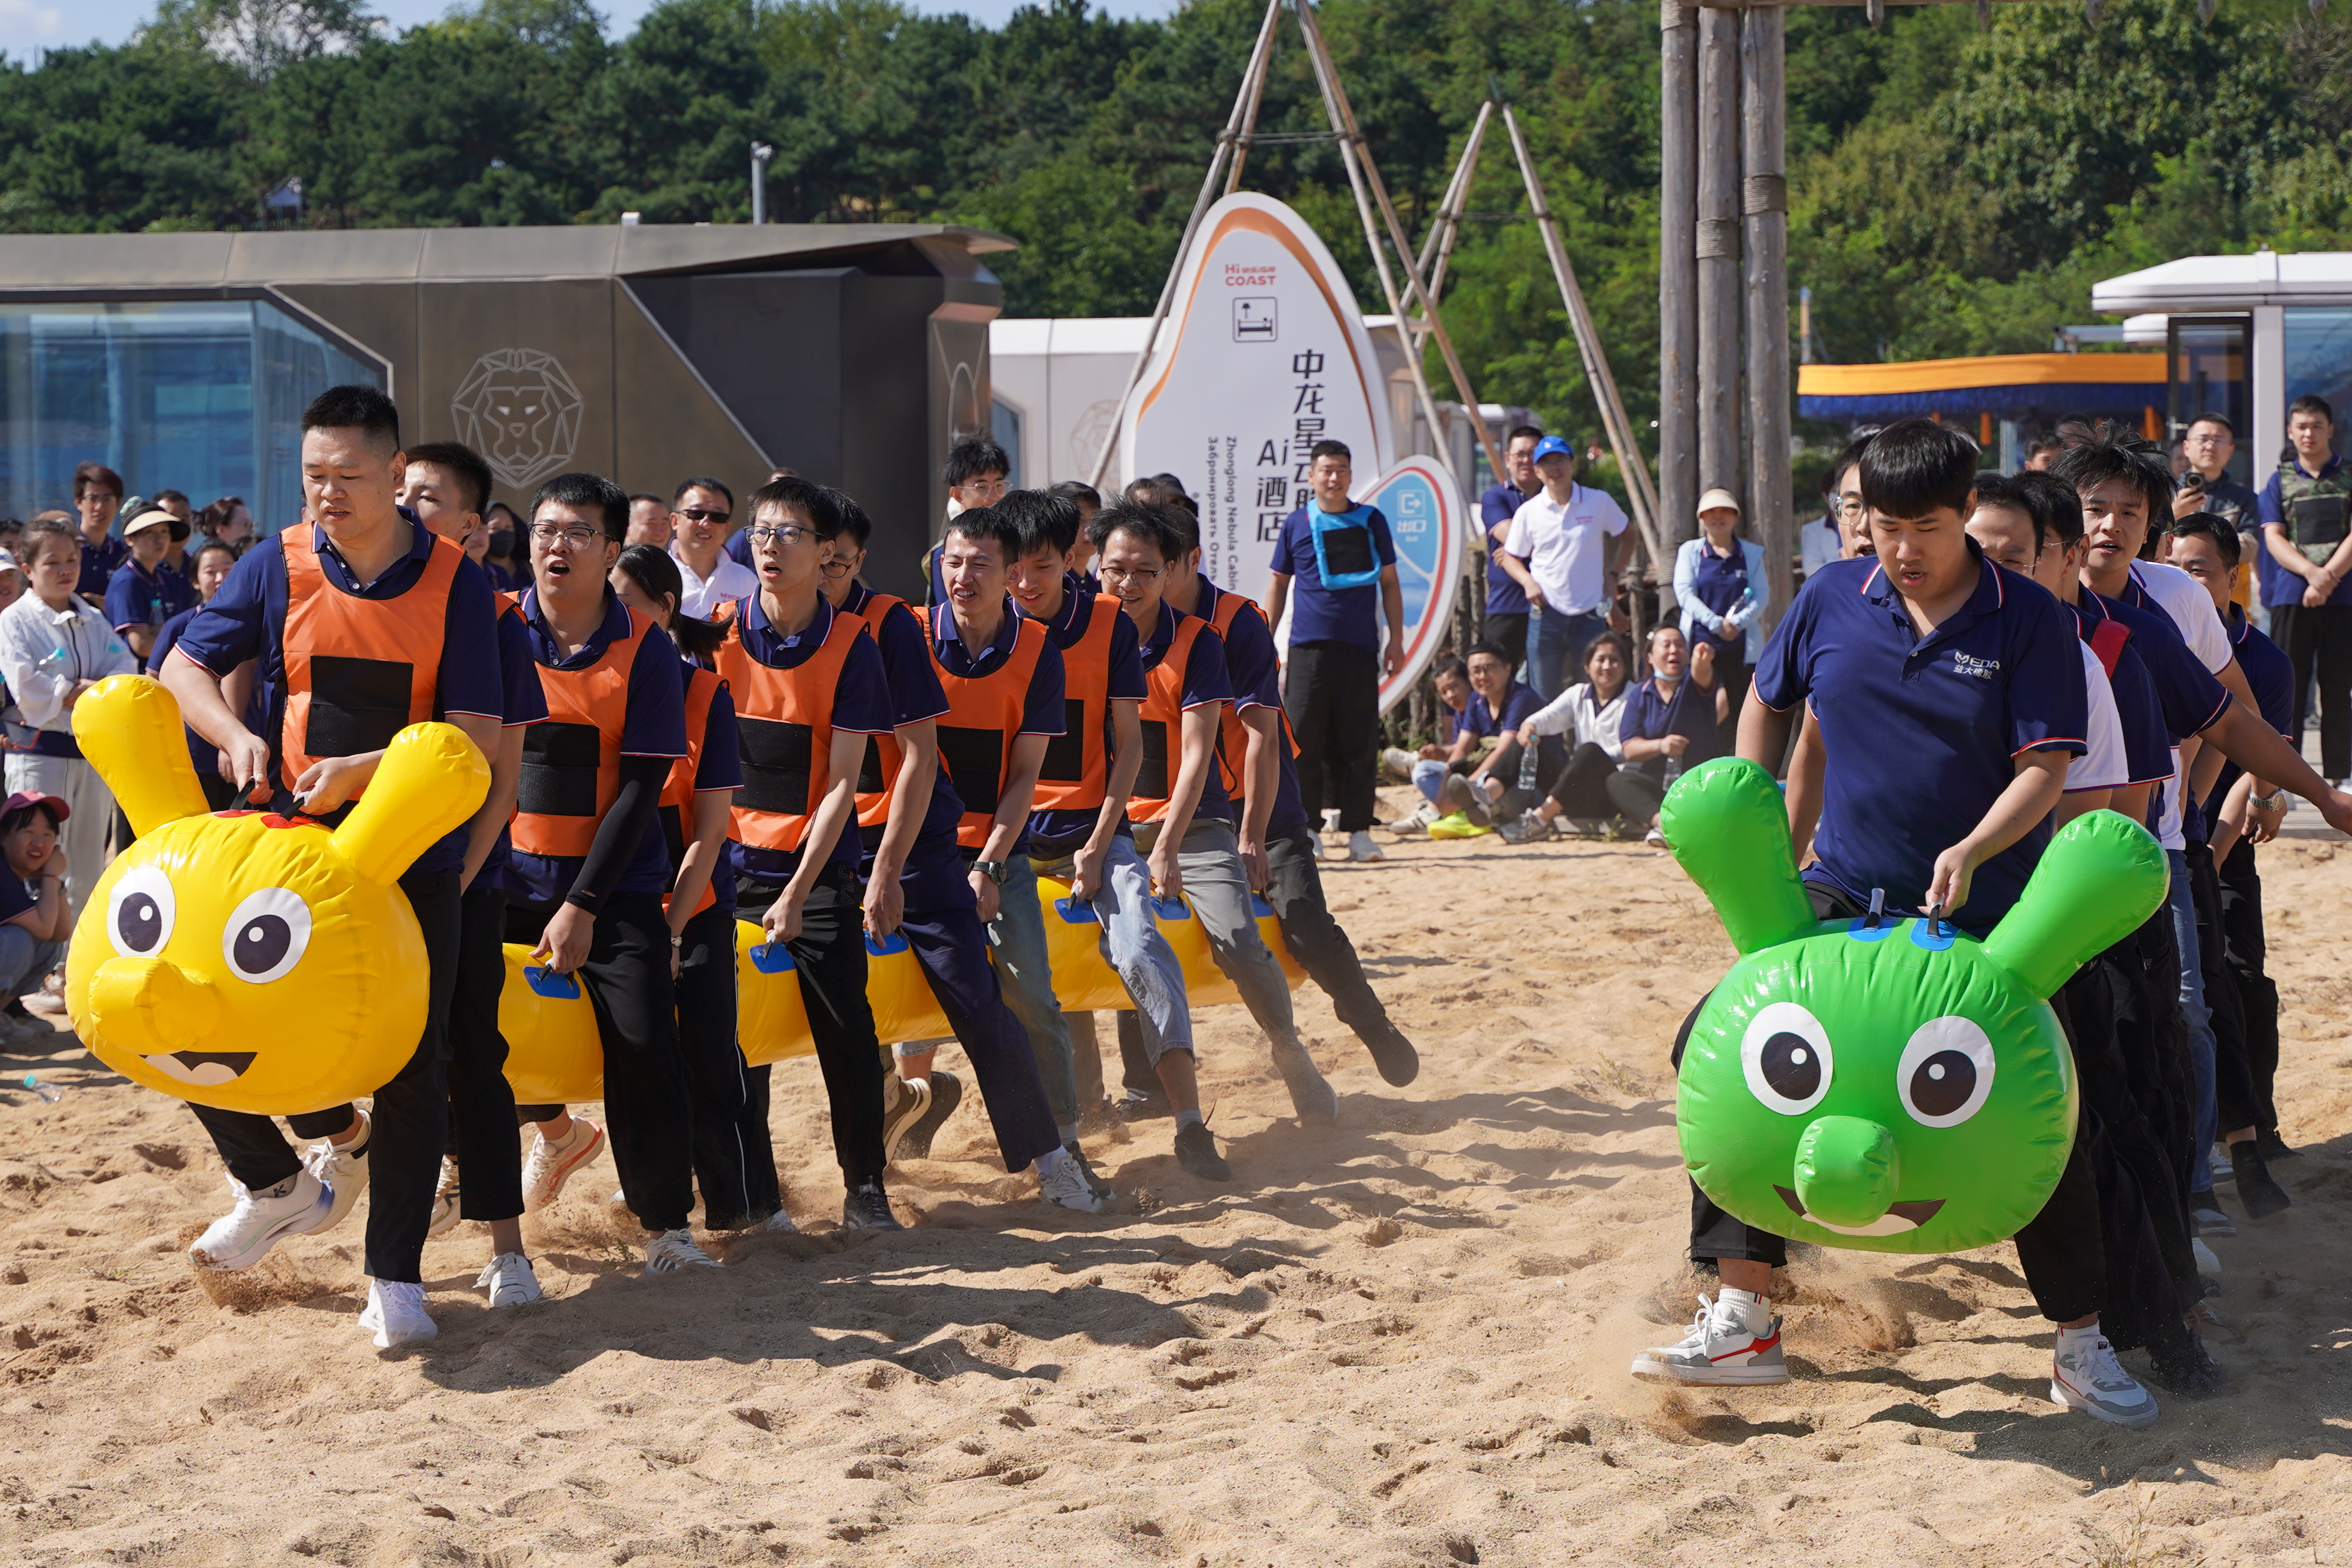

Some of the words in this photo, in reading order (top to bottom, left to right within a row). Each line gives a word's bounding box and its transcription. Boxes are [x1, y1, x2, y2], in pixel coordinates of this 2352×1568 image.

[1225, 275, 1276, 286] COAST
[1224, 436, 1238, 503] Zhonglong
[1227, 507, 1238, 551] Nebula
[1396, 519, 1427, 533] 出口
[1209, 542, 1220, 581] Отель
[1228, 555, 1239, 590] Cabin
[1953, 664, 1993, 679] 益大橡胶
